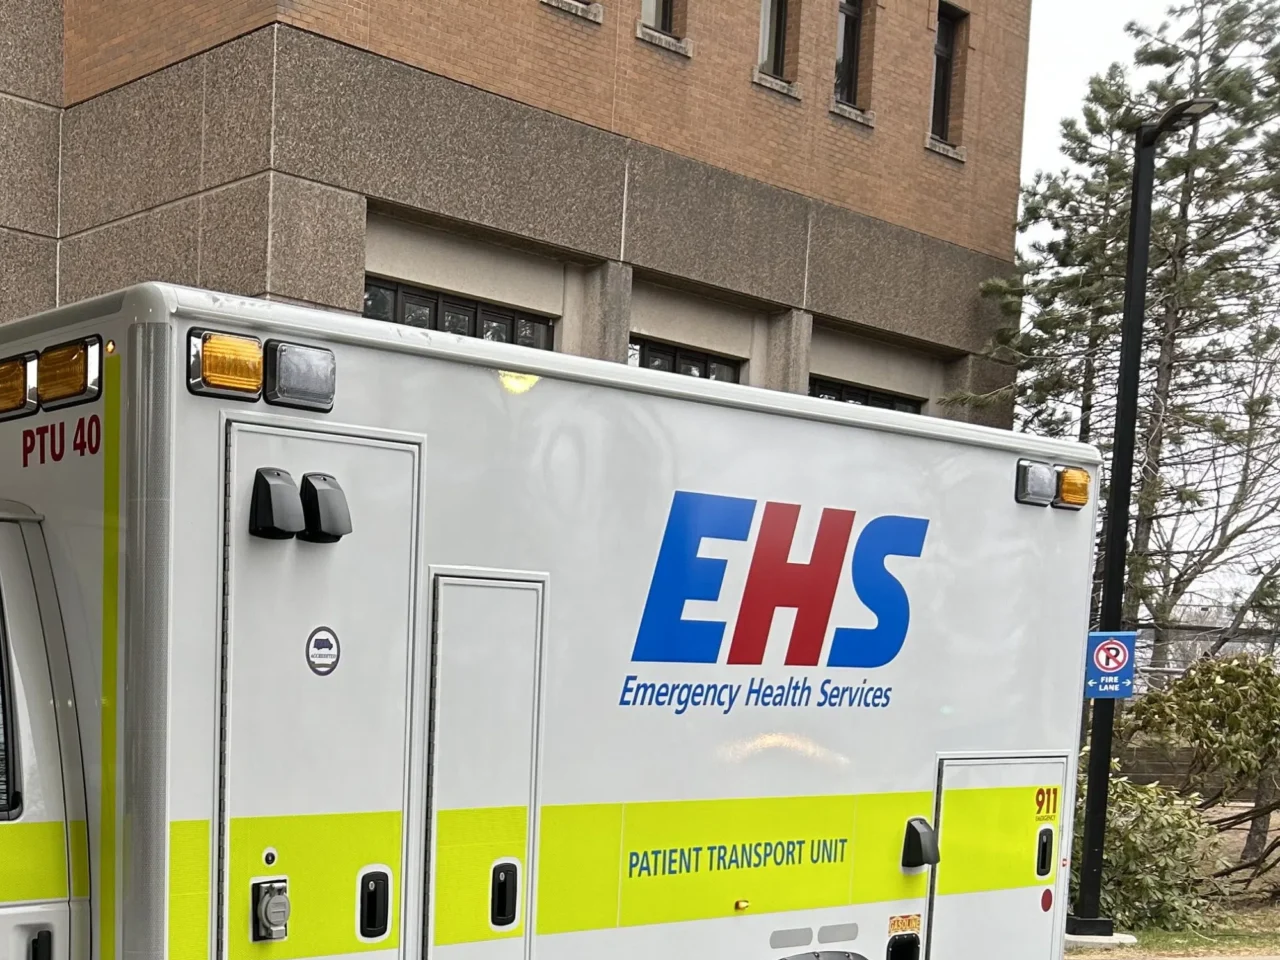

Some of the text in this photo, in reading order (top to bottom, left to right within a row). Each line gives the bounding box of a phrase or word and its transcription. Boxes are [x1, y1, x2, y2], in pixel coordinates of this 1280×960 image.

[22, 414, 101, 468] PTU 40
[631, 490, 930, 668] EHS
[619, 675, 892, 714] Emergency Health Services
[1035, 787, 1058, 815] 911
[628, 838, 848, 879] PATIENT TRANSPORT UNIT
